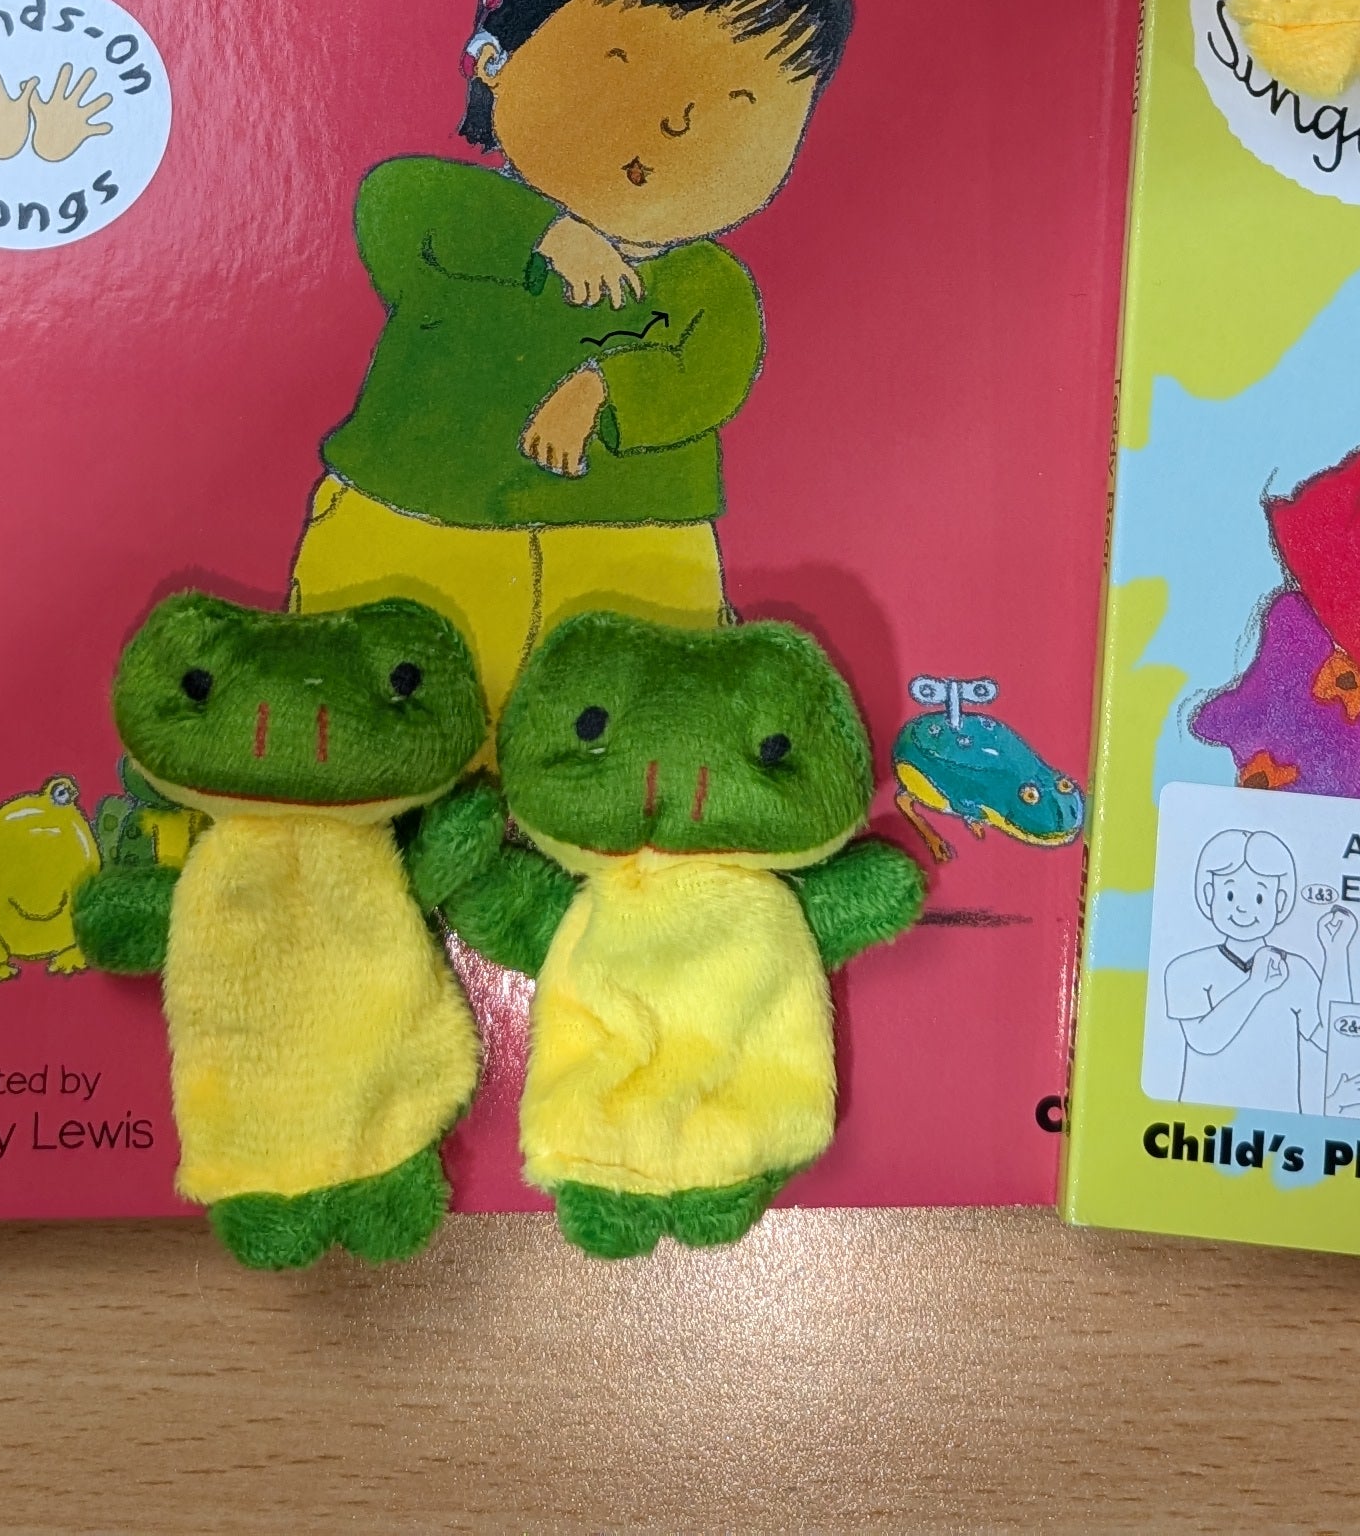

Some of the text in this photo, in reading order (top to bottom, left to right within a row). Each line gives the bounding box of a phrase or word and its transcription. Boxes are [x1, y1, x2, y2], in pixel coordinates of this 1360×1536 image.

[1306, 886, 1333, 902] 1&3
[60, 1064, 102, 1101] by
[31, 1110, 155, 1151] Lewis
[1142, 1121, 1305, 1173] Child's
